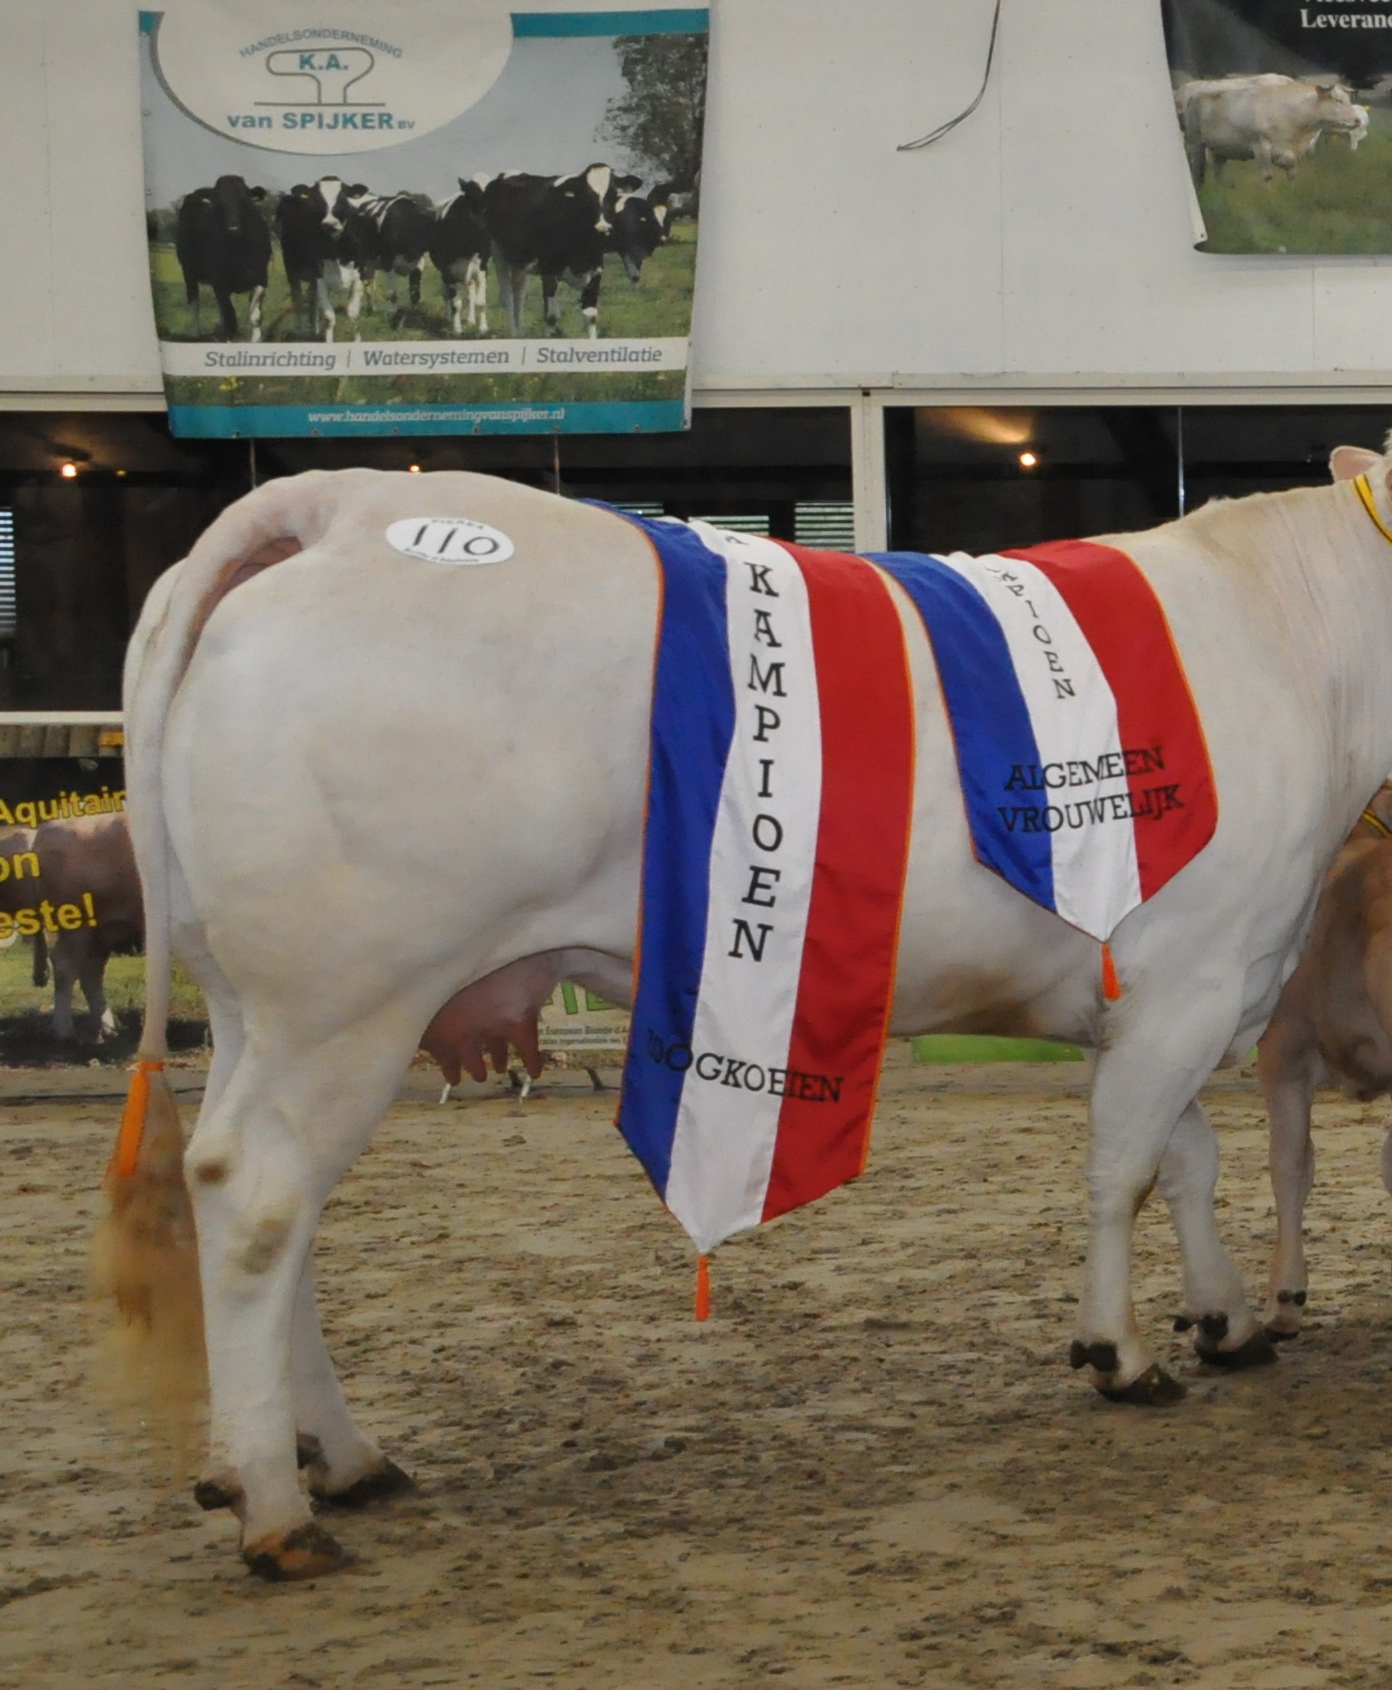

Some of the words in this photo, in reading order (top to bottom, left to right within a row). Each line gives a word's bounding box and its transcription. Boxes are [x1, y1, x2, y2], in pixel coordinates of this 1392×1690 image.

[239, 28, 403, 59] HANDELSONDERNEMING
[299, 54, 349, 70] K.A.
[227, 115, 272, 129] van
[282, 113, 394, 130] SPIJKER
[398, 120, 415, 129] BV
[204, 350, 337, 370] Stalinrichting
[363, 348, 509, 370] Watersystemen
[536, 346, 663, 365] Stalventilatie
[308, 406, 565, 423] www.handelsondernemingvanspijker.nl
[413, 524, 500, 555] 110
[728, 561, 789, 963] KAMPIOEN
[1004, 745, 1166, 791] ALGEMEEN
[997, 784, 1186, 833] VROUWELIJK
[646, 1027, 845, 1102] OOGKOEIEN
